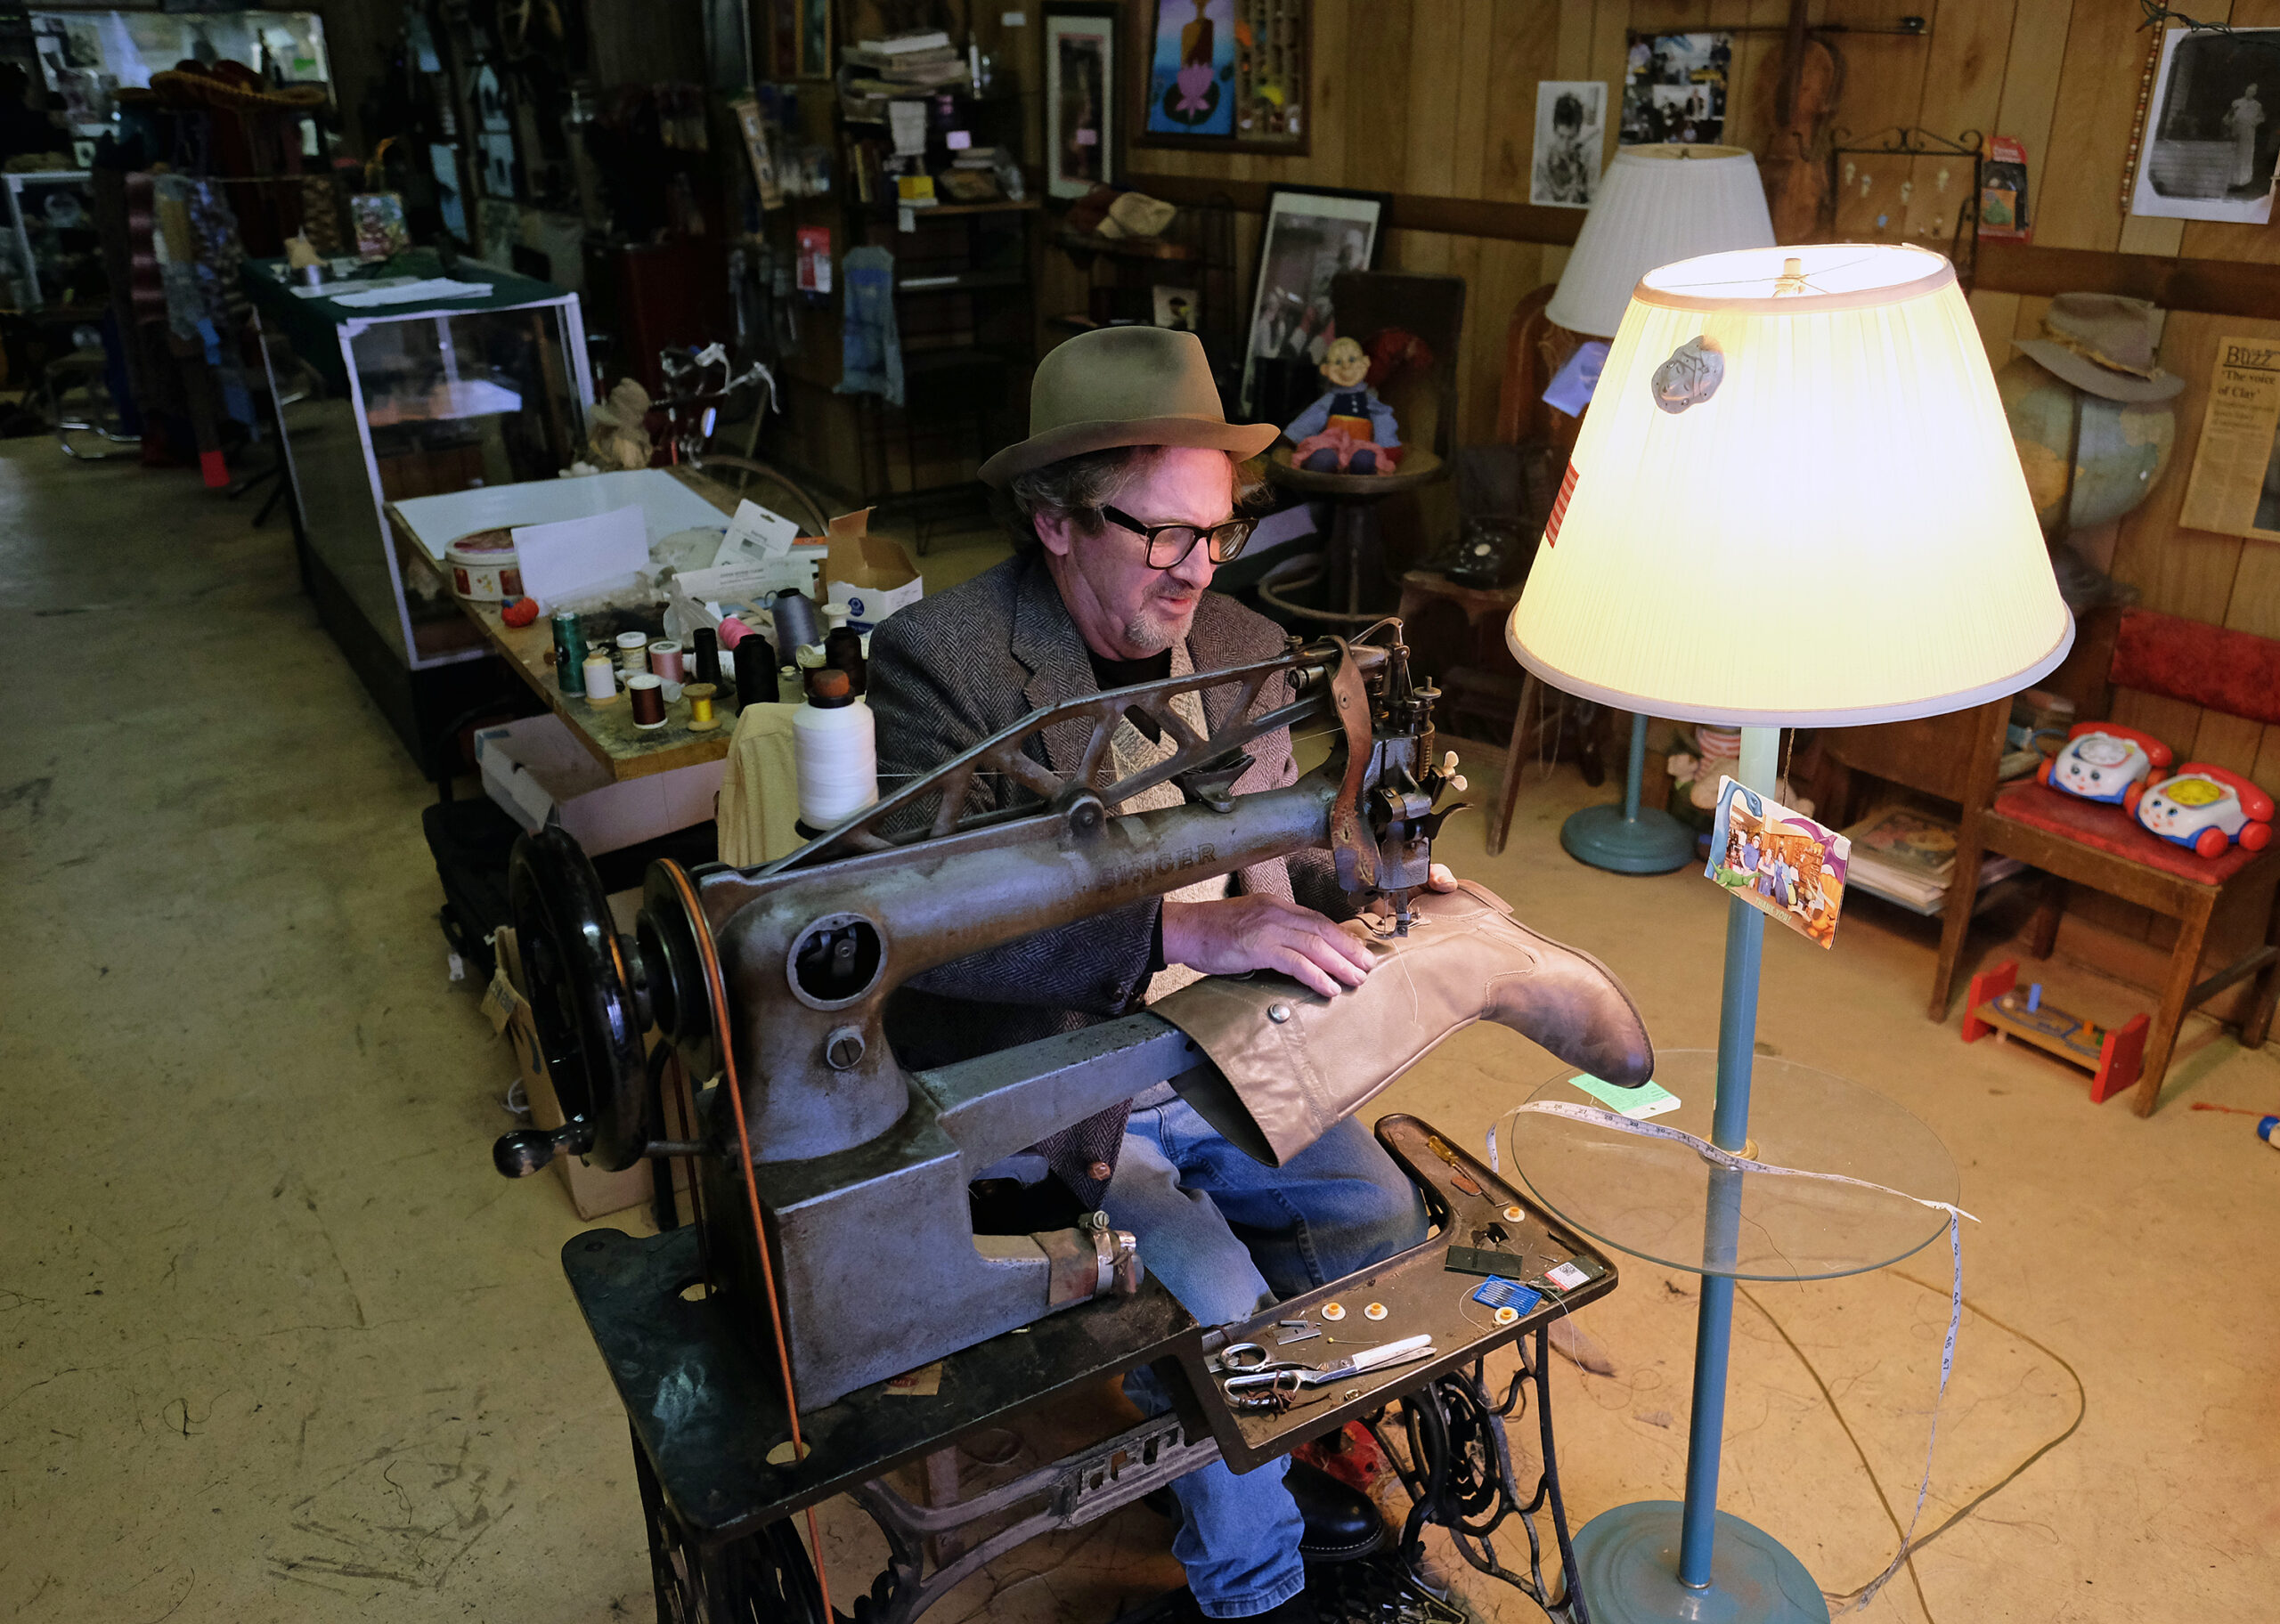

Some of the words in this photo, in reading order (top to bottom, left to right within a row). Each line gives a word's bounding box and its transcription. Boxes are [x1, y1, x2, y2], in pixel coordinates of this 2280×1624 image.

[2218, 386, 2230, 395] of
[1098, 843, 1217, 891] SINGER
[1755, 897, 1775, 914] THANK
[1775, 908, 1792, 923] YOU!
